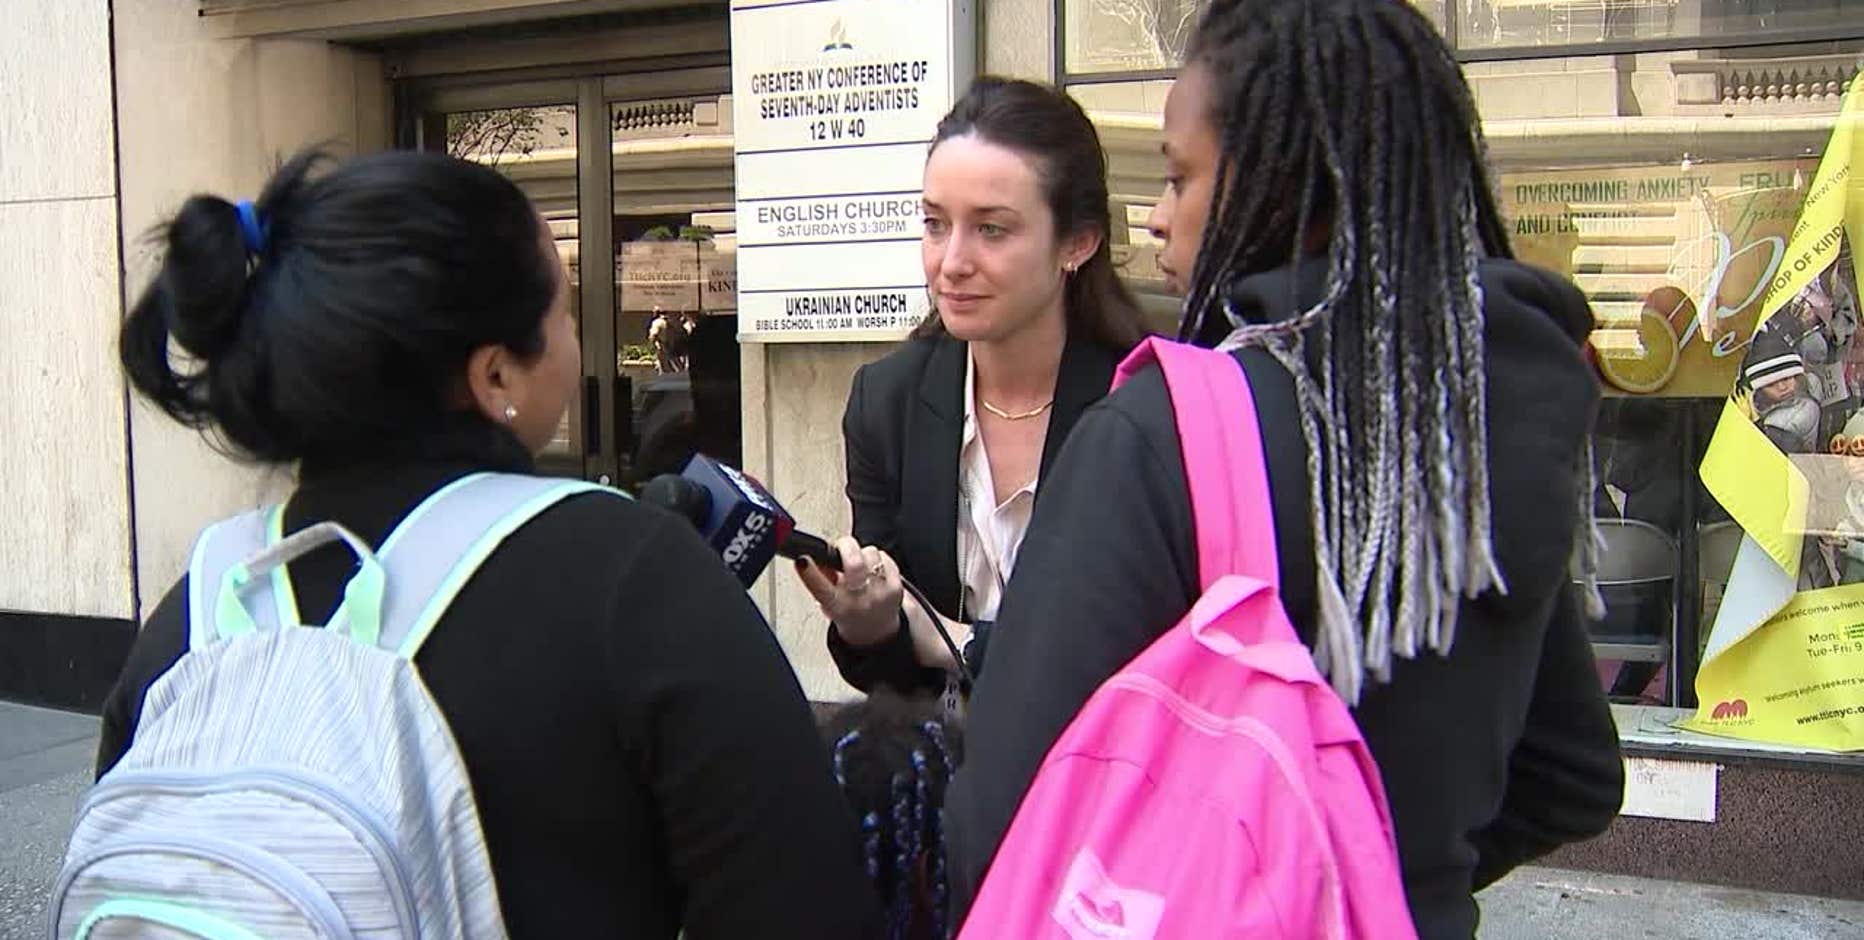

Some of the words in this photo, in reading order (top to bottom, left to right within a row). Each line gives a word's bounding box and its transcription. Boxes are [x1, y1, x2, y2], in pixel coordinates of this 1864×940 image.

[751, 70, 804, 95] GREATER
[807, 68, 823, 91] NY
[827, 62, 907, 89] CONFERENCE
[912, 60, 928, 82] OF
[760, 93, 840, 120] SEVENTH-DAY
[844, 87, 919, 113] ADVENTISTS
[810, 121, 826, 141] 12
[831, 119, 843, 139] W
[848, 118, 865, 138] 40
[1515, 180, 1629, 203] OVERCOMING
[1635, 175, 1712, 201] ANXIETY
[757, 203, 839, 224] ENGLISH
[1515, 213, 1551, 235] AND
[777, 222, 857, 238] SATURDAYS
[860, 220, 907, 234] 3:30PM
[1793, 252, 1813, 272] OF
[1812, 220, 1844, 256] KIND
[785, 295, 851, 317] UKRAINIAN
[854, 293, 907, 315] CHURCH
[755, 319, 779, 331] BIBLE
[780, 318, 814, 331] SCHOOL
[840, 317, 853, 329] AM
